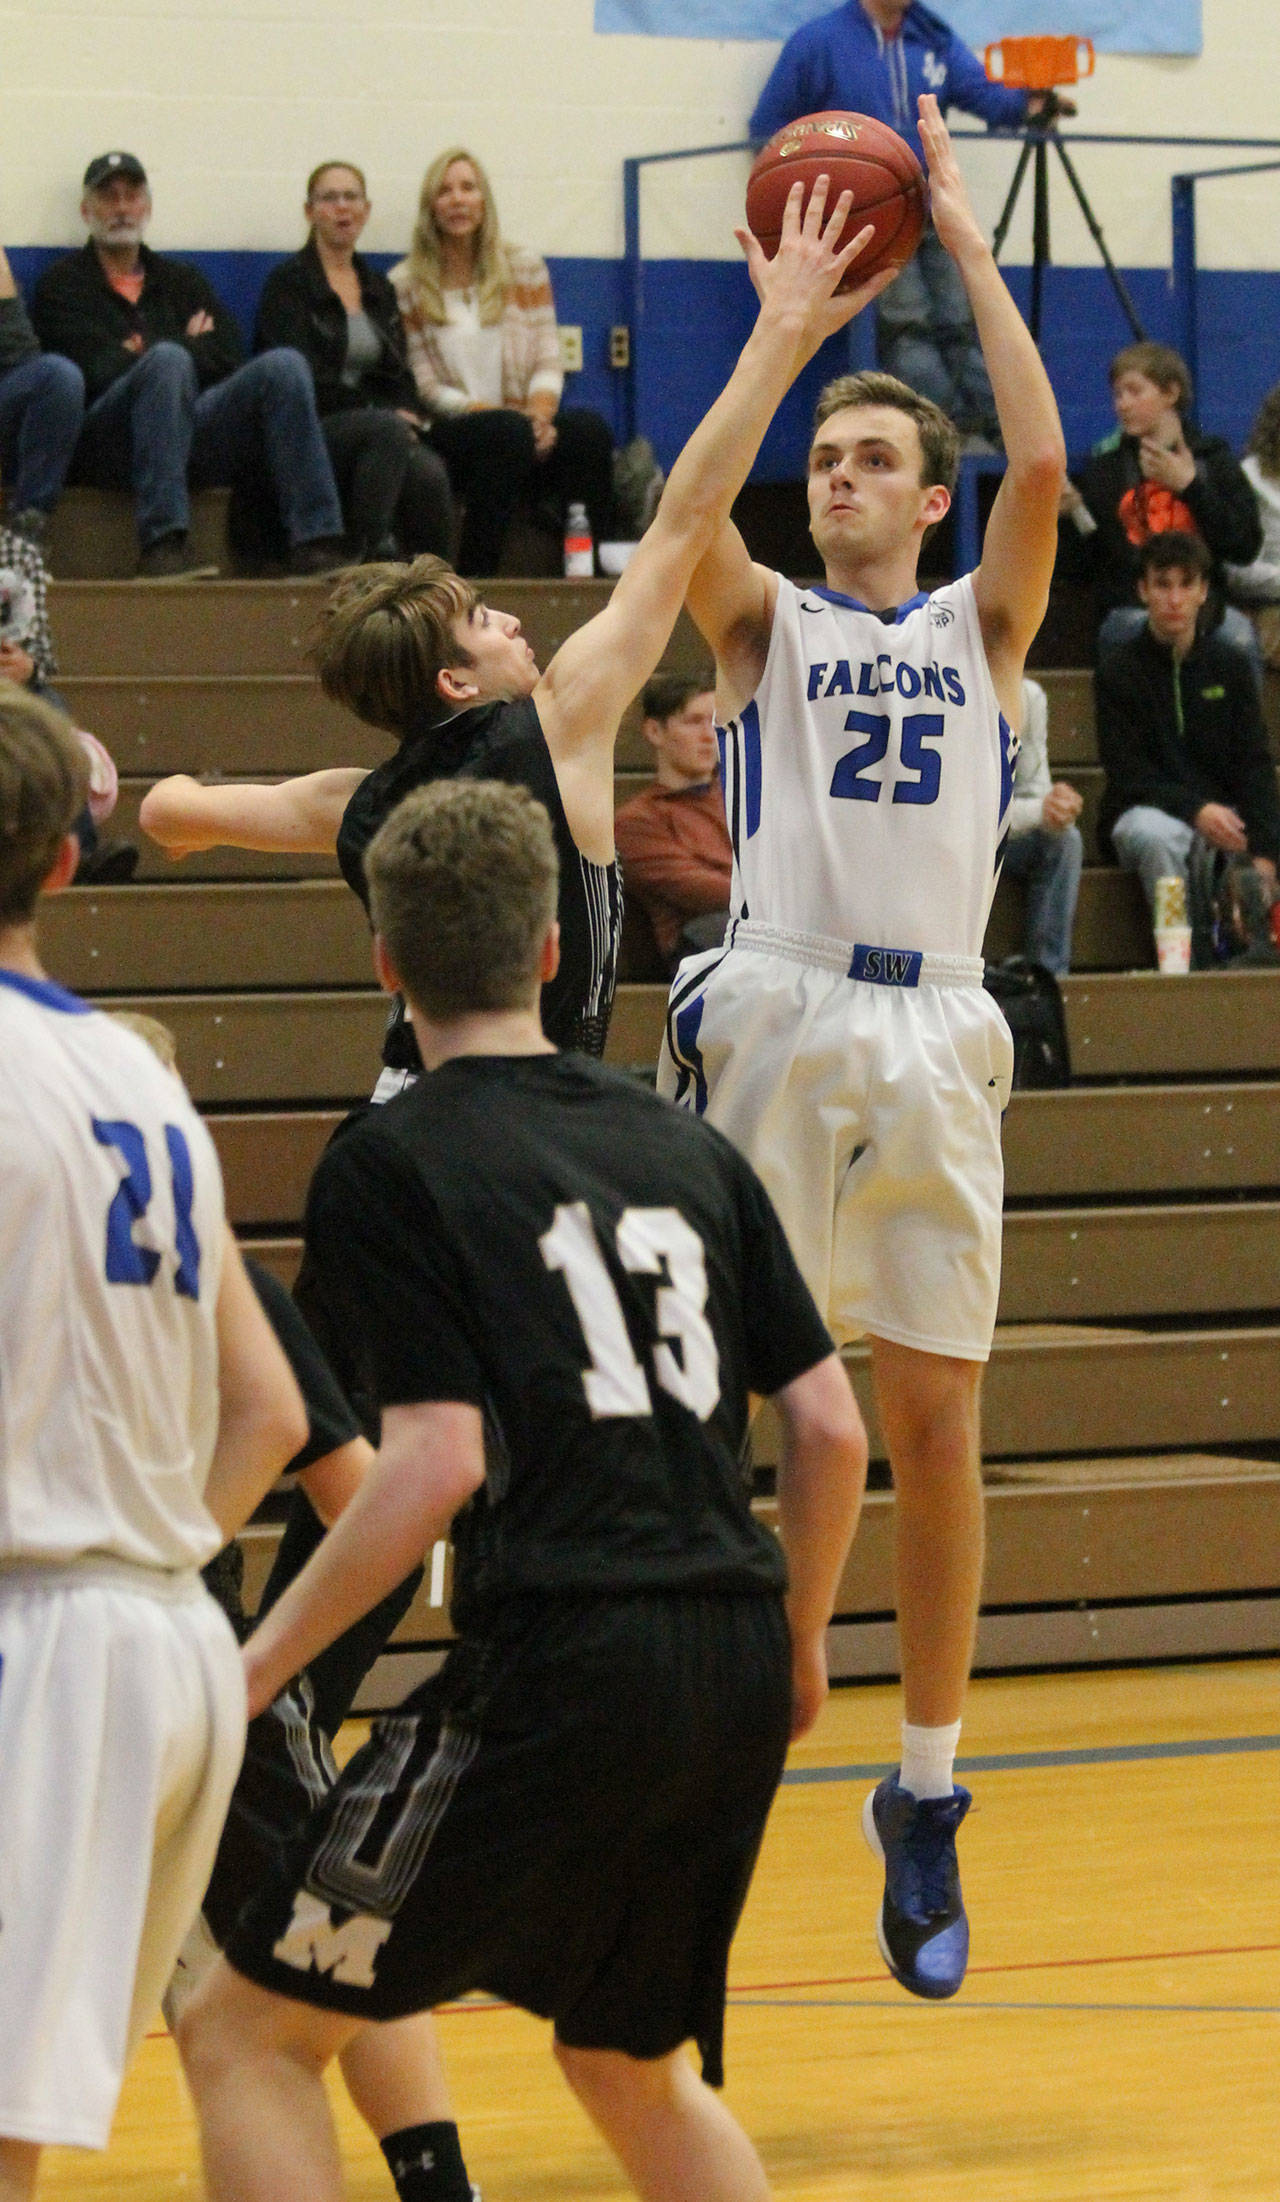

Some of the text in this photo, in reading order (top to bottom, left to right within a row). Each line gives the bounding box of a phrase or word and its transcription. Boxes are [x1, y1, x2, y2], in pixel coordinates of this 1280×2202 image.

[807, 653, 966, 707] FALCONS
[829, 710, 945, 805] 25
[863, 949, 913, 984] SW
[91, 1116, 201, 1302] 21
[537, 1200, 721, 1423] 13
[272, 1888, 393, 1990] M
